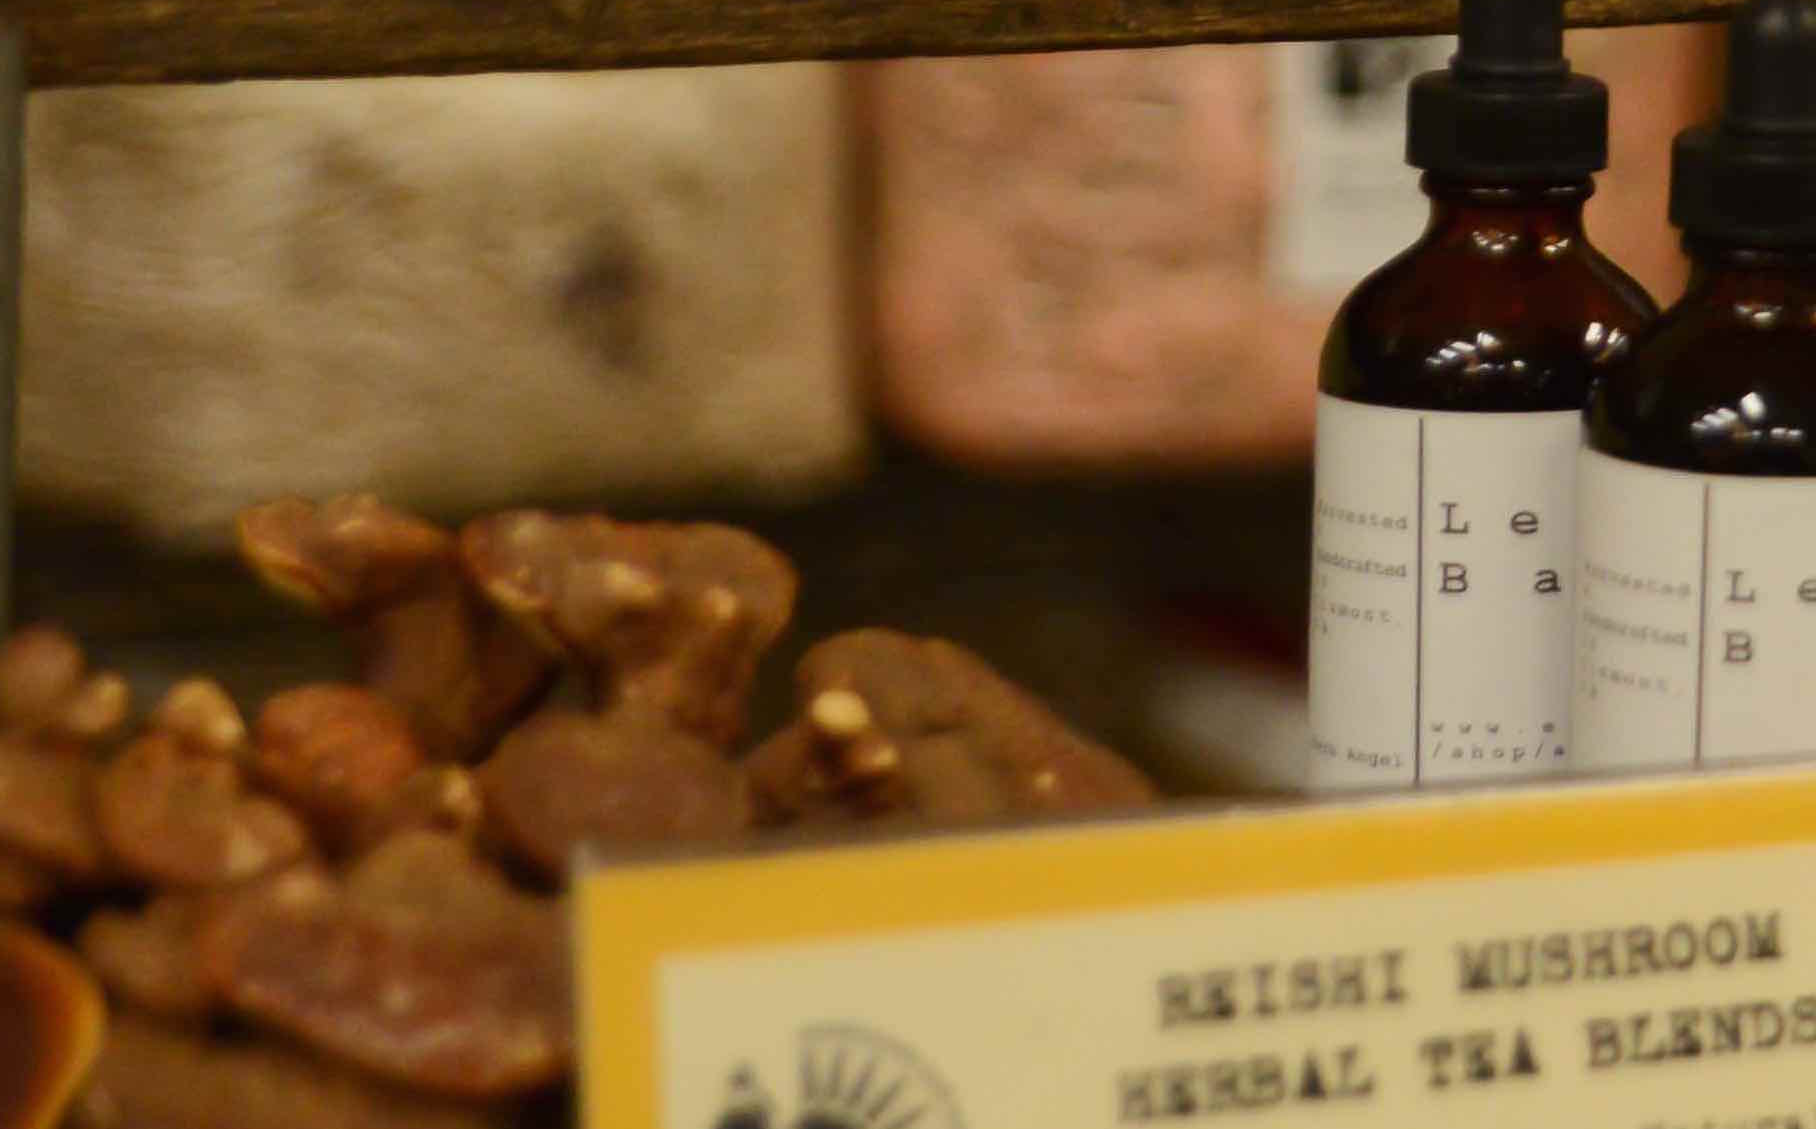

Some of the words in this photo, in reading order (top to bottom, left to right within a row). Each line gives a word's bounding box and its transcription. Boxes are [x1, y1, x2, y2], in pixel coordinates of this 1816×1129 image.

[1155, 948, 1410, 1030] REISHI
[1454, 909, 1784, 996] MUSHROOM
[1116, 1045, 1375, 1126] HERBAL
[1418, 1025, 1541, 1090] TEA
